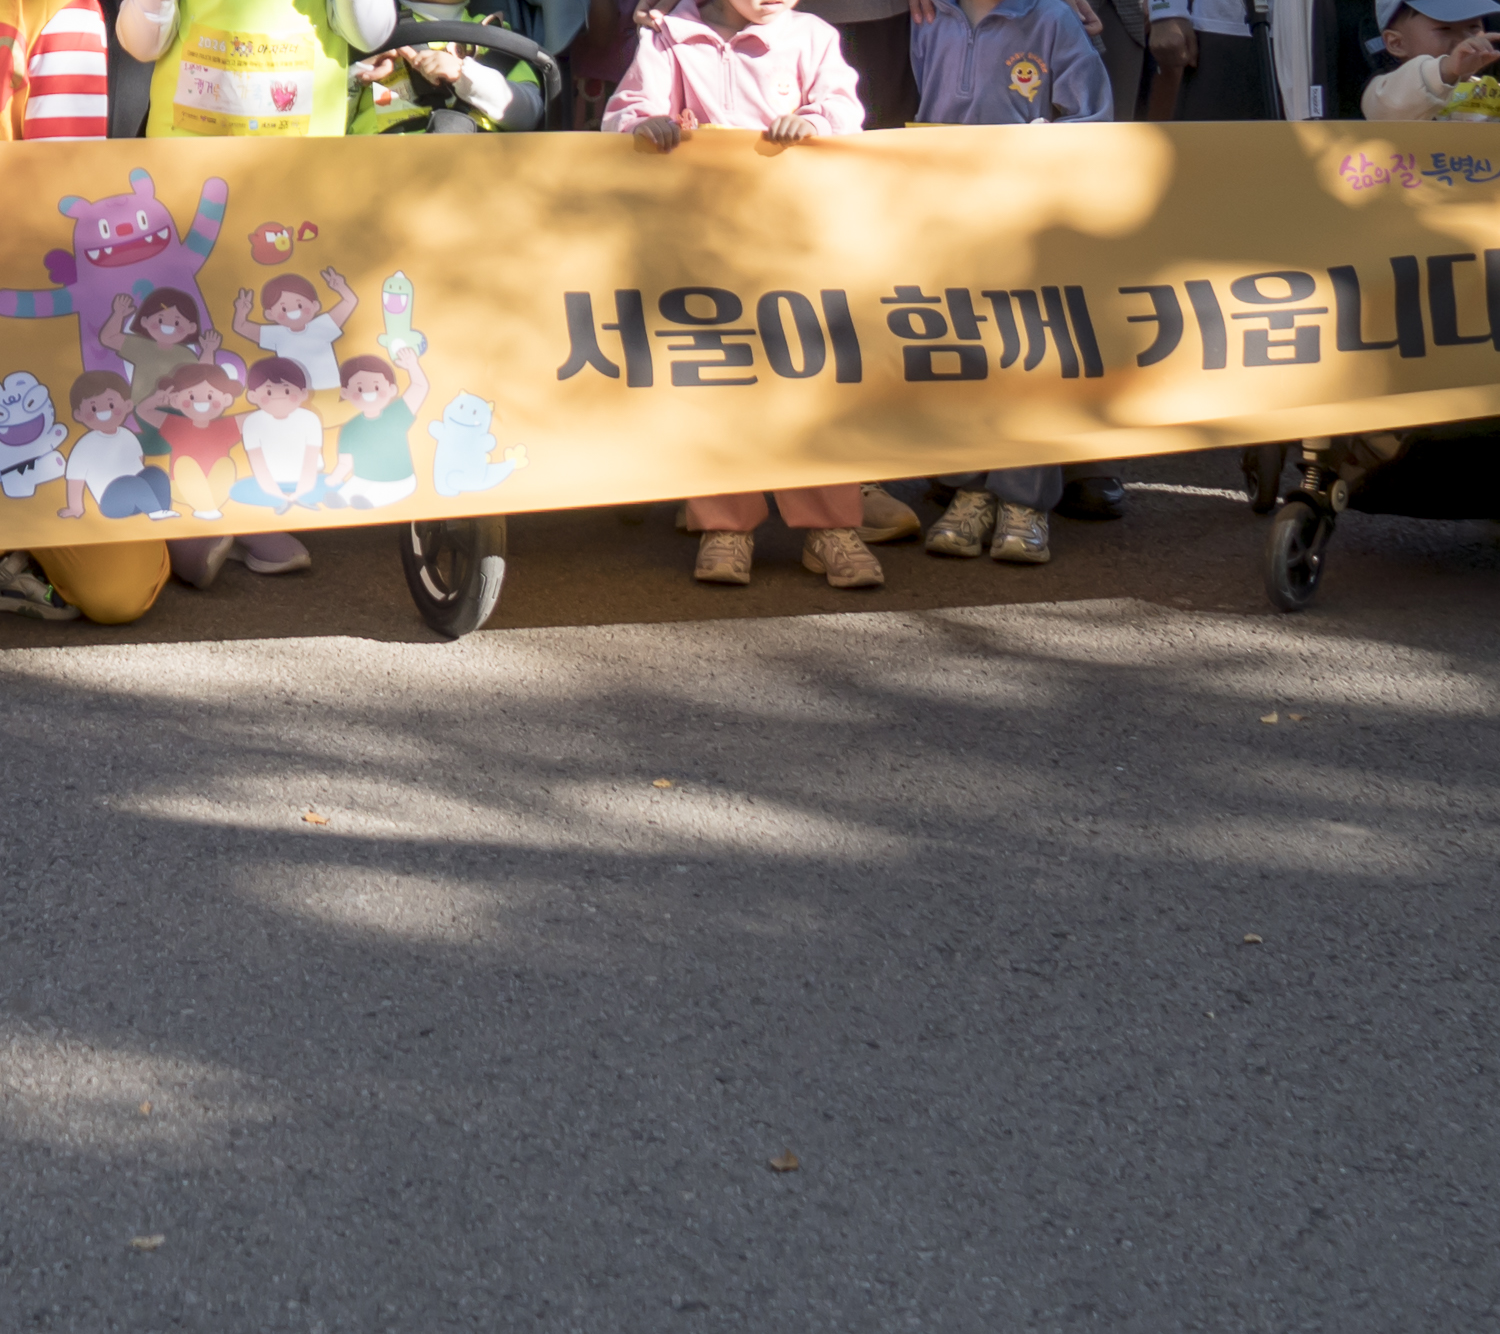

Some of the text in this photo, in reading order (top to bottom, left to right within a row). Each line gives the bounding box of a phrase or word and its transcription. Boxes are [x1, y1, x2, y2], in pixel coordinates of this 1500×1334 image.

[198, 36, 227, 54] 2026
[556, 285, 864, 389] 서울이
[879, 282, 1104, 382] 함께
